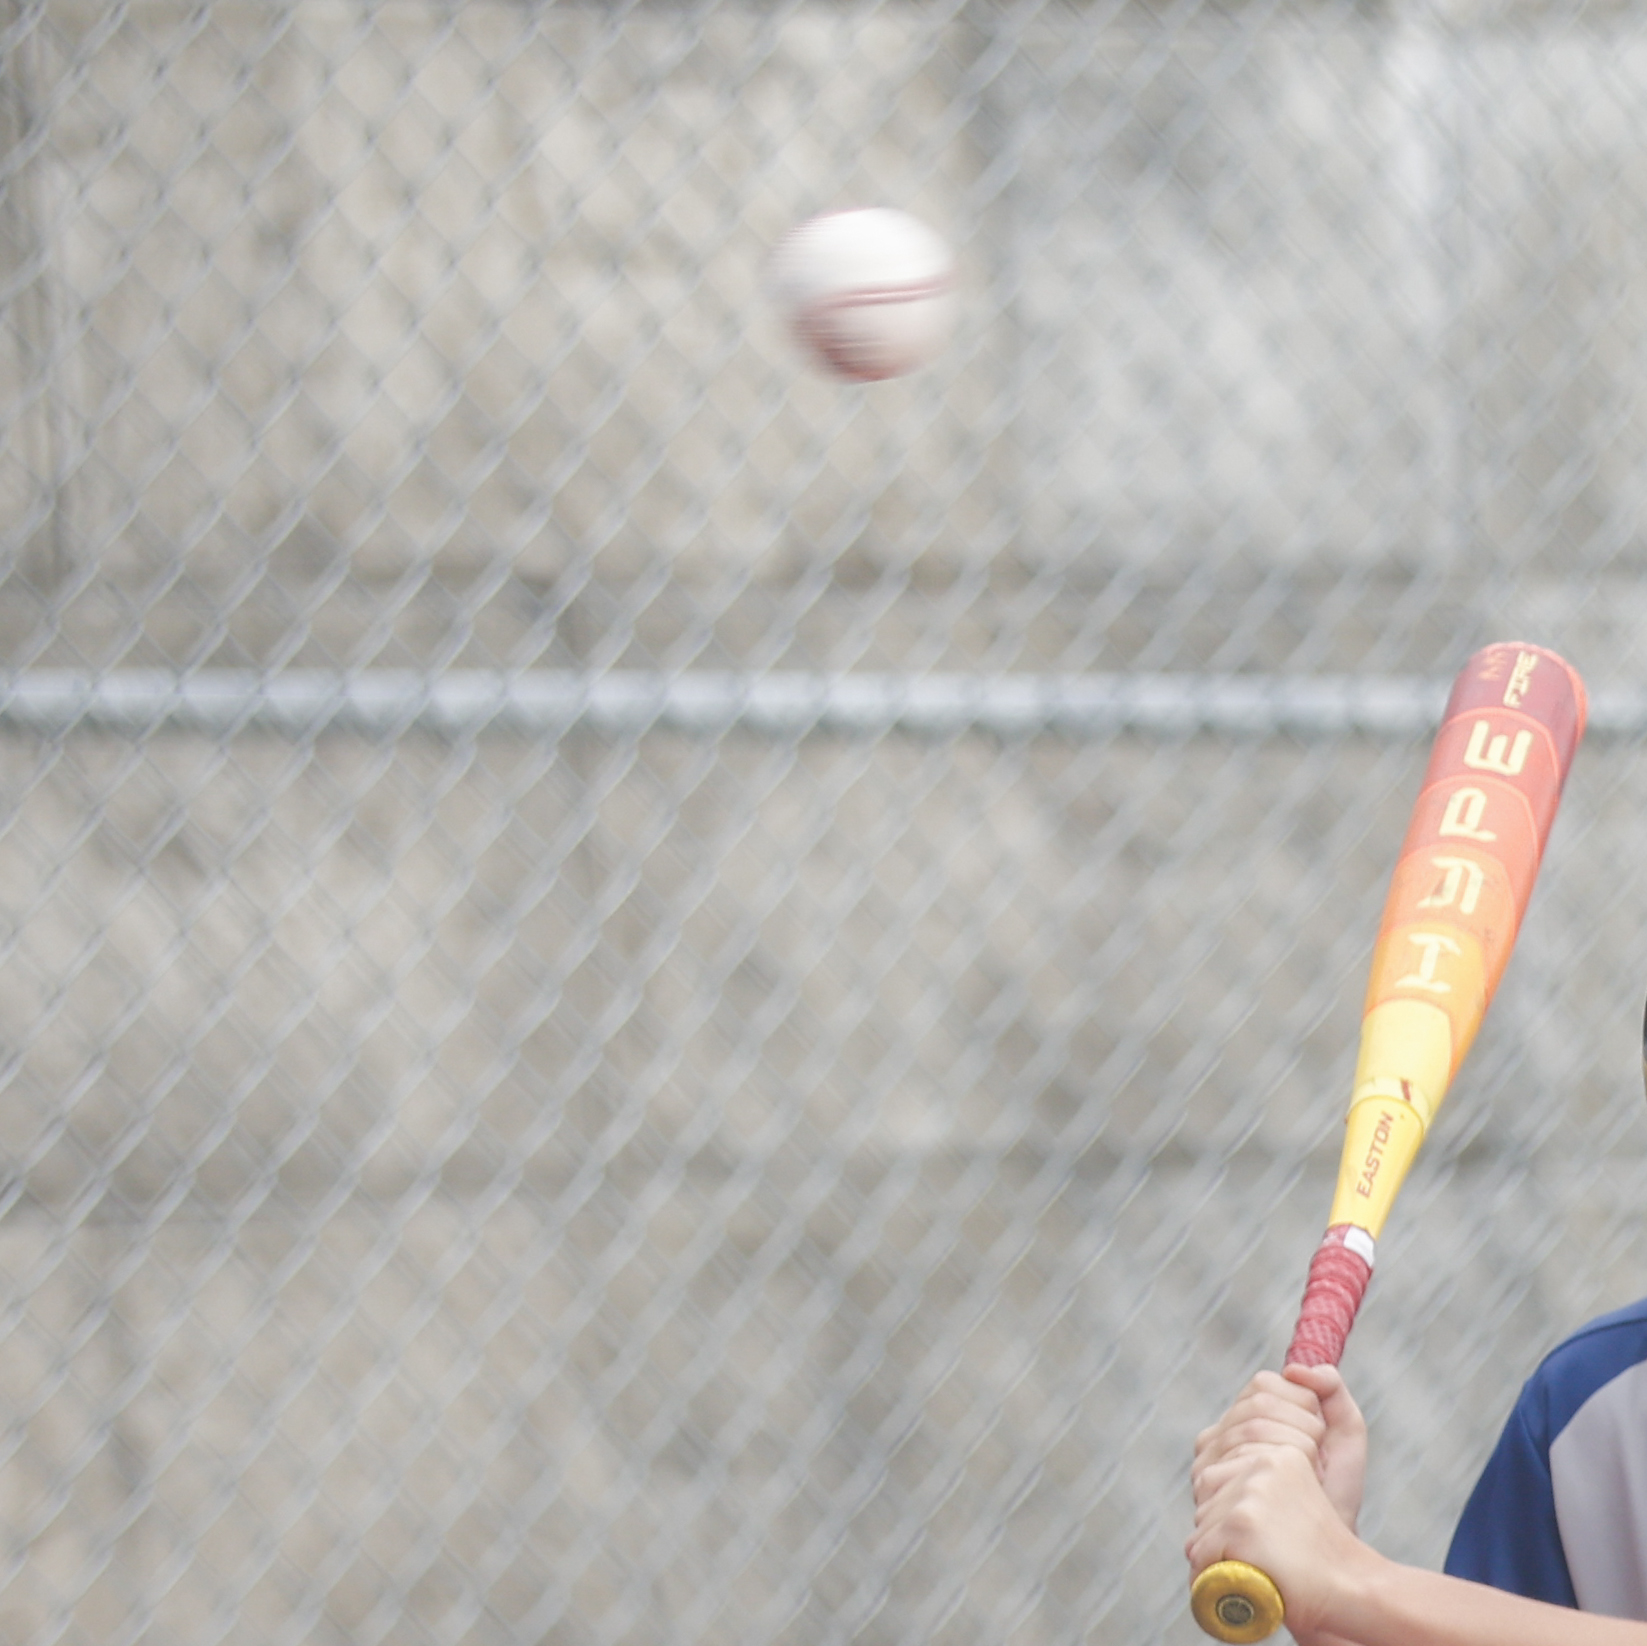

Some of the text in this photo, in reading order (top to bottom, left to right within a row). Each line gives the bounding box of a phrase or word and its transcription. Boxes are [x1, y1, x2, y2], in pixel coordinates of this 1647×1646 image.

[1503, 650, 1538, 708] FIRE
[1395, 720, 1533, 994] HYPE
[1356, 1111, 1394, 1199] EASTON
